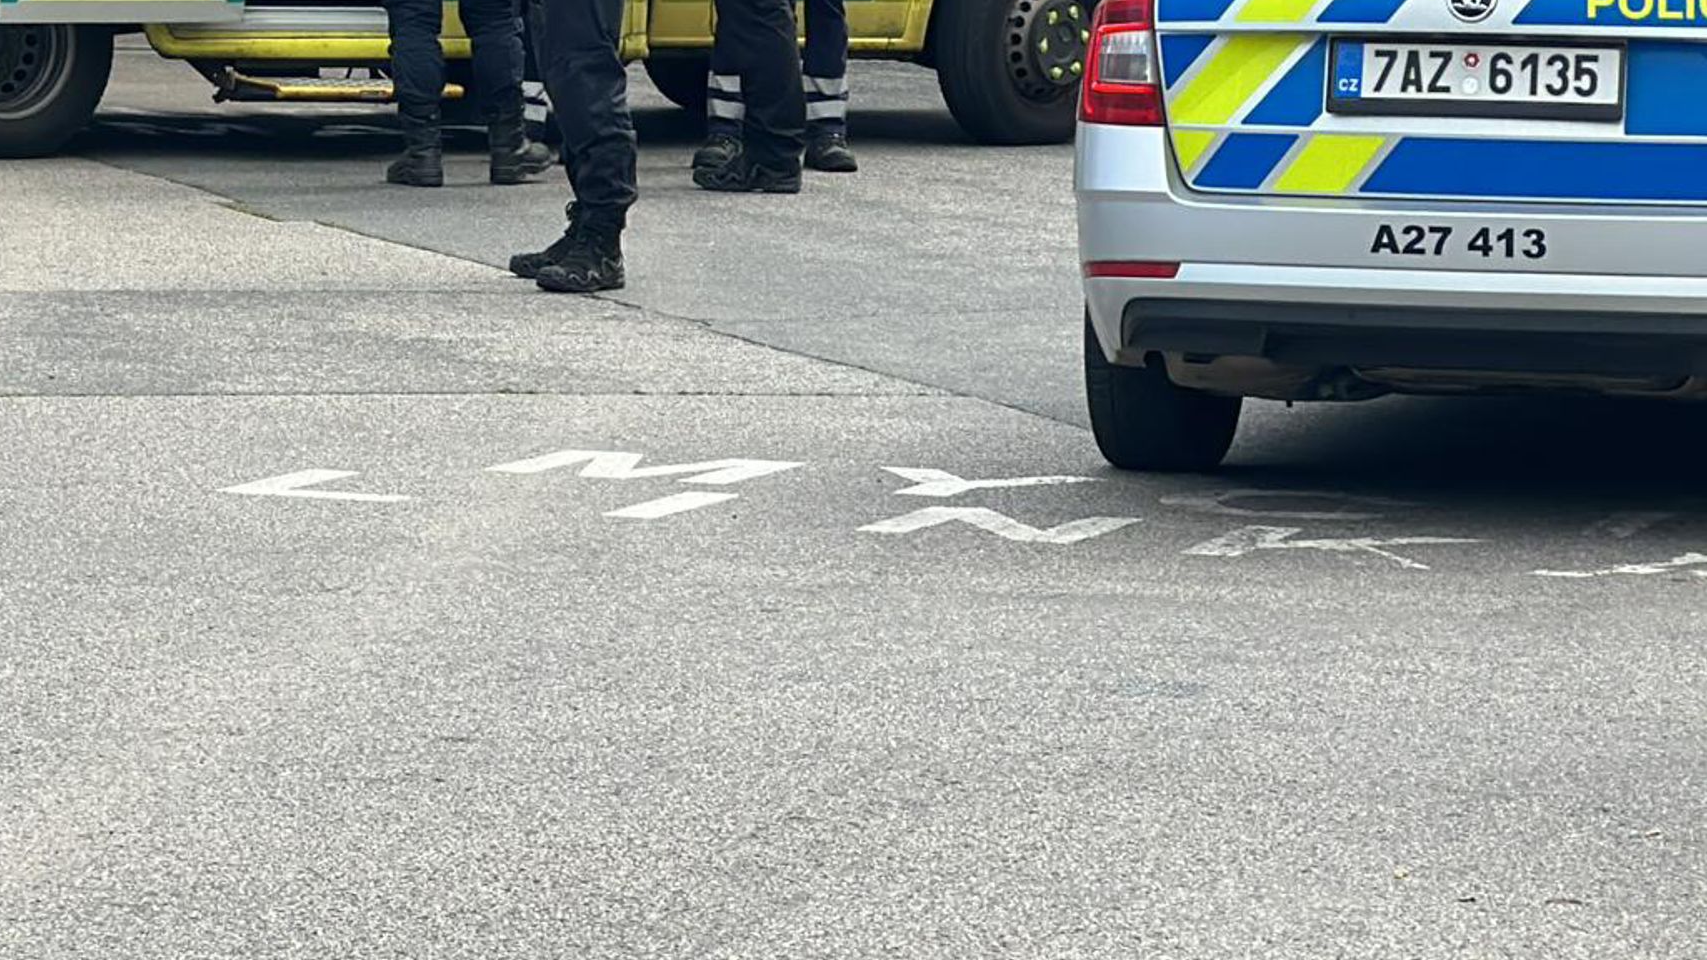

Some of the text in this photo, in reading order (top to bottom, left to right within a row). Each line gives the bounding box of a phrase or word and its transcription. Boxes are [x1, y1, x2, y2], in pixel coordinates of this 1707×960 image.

[1339, 49, 1600, 98] CZ 7AZ 6135
[1370, 224, 1548, 259] A27 413
